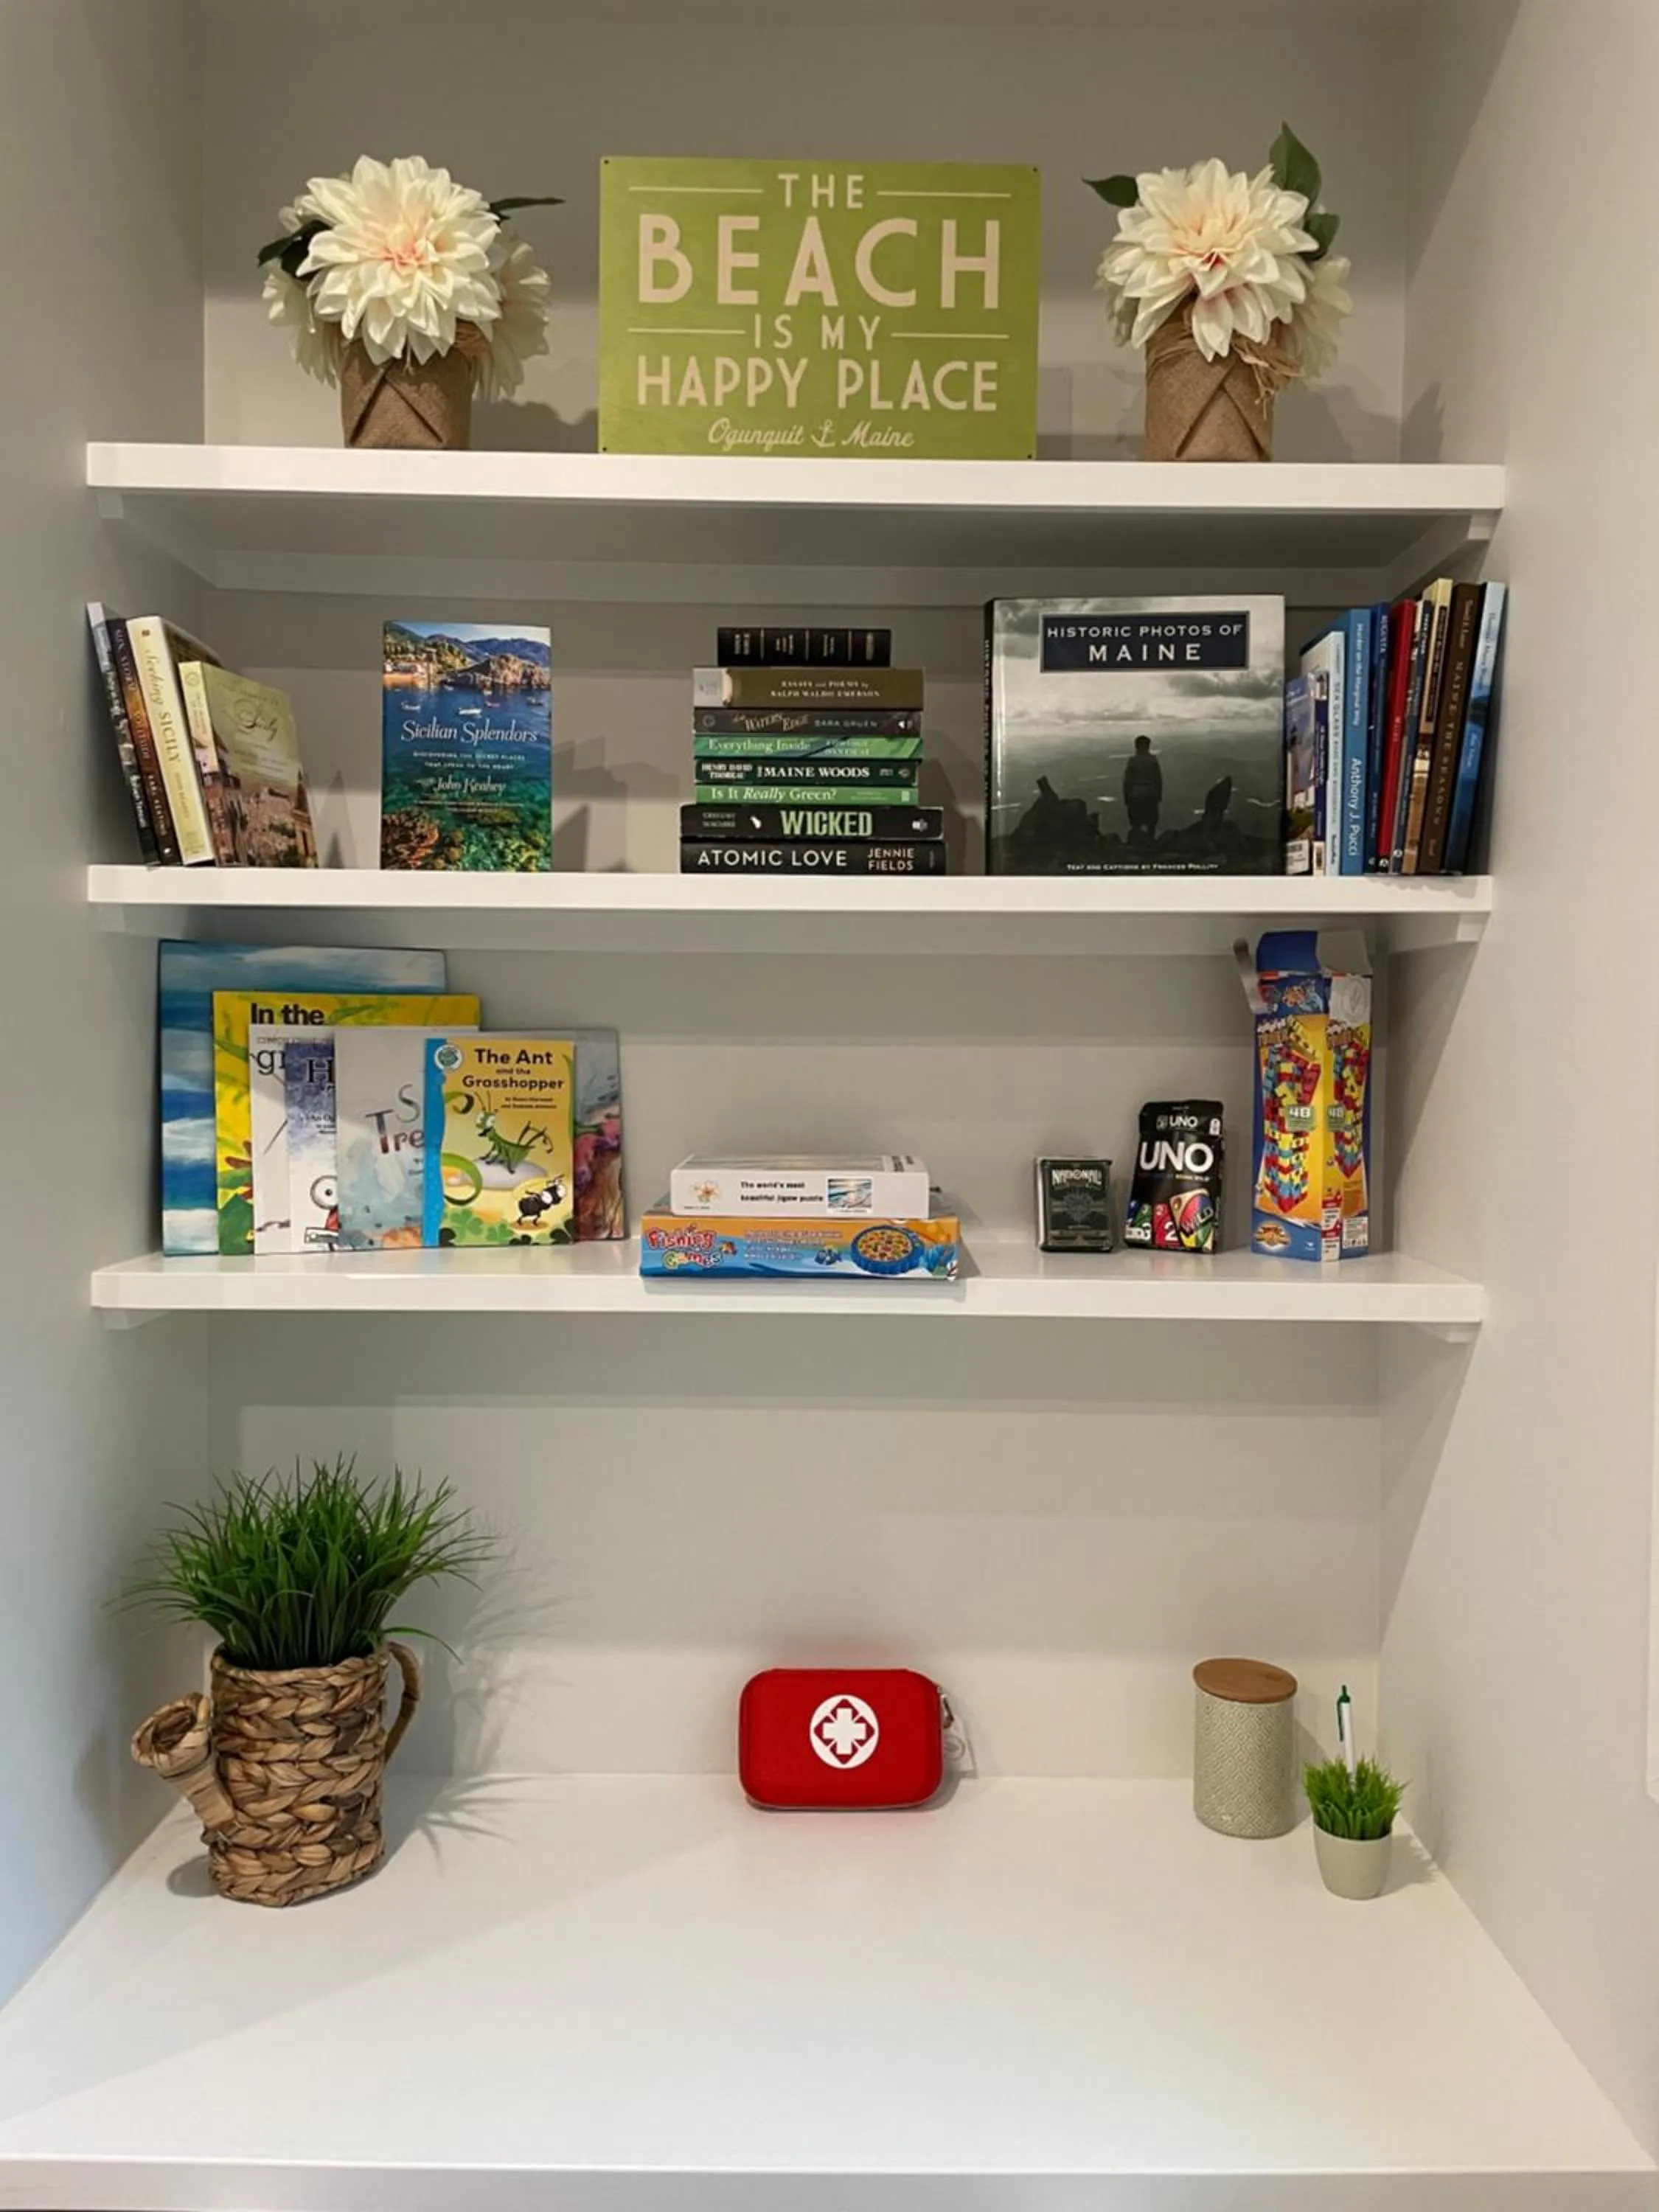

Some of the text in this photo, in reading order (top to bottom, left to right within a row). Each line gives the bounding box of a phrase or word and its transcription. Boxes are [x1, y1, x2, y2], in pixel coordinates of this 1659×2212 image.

[778, 173, 864, 208] THE
[639, 213, 1000, 309] BEACH
[754, 313, 881, 350] IS MY
[637, 355, 997, 412] HAPPY PLACE
[707, 417, 914, 452] Ogunquit Maine
[1047, 624, 1243, 639] HISTORIC PHOTOS OF
[1089, 643, 1202, 662] MAINE
[158, 710, 181, 764] SICILY
[400, 715, 538, 746] Sicilian Splendors
[709, 739, 773, 752] Everything
[776, 740, 810, 751] Inside
[764, 767, 814, 778] MAINE
[819, 768, 870, 778] WOODS
[433, 774, 462, 793] John
[711, 788, 724, 799] Is
[728, 788, 738, 799] It
[743, 788, 786, 802] Really
[789, 788, 837, 800] Green?
[1347, 757, 1362, 856] Anthony J. Pucci
[780, 810, 872, 836] WICKED
[698, 850, 847, 866] ATOMIC LOVE
[867, 848, 914, 859] JENNIE
[868, 860, 914, 871] FIELDS
[251, 1003, 324, 1025] In the
[474, 1048, 553, 1065] The Ant
[462, 1075, 565, 1091] Grasshopper
[1169, 1116, 1197, 1127] UNO
[1290, 1107, 1311, 1118] 48
[1140, 1141, 1214, 1173] UNO
[1180, 1206, 1214, 1232] WILD
